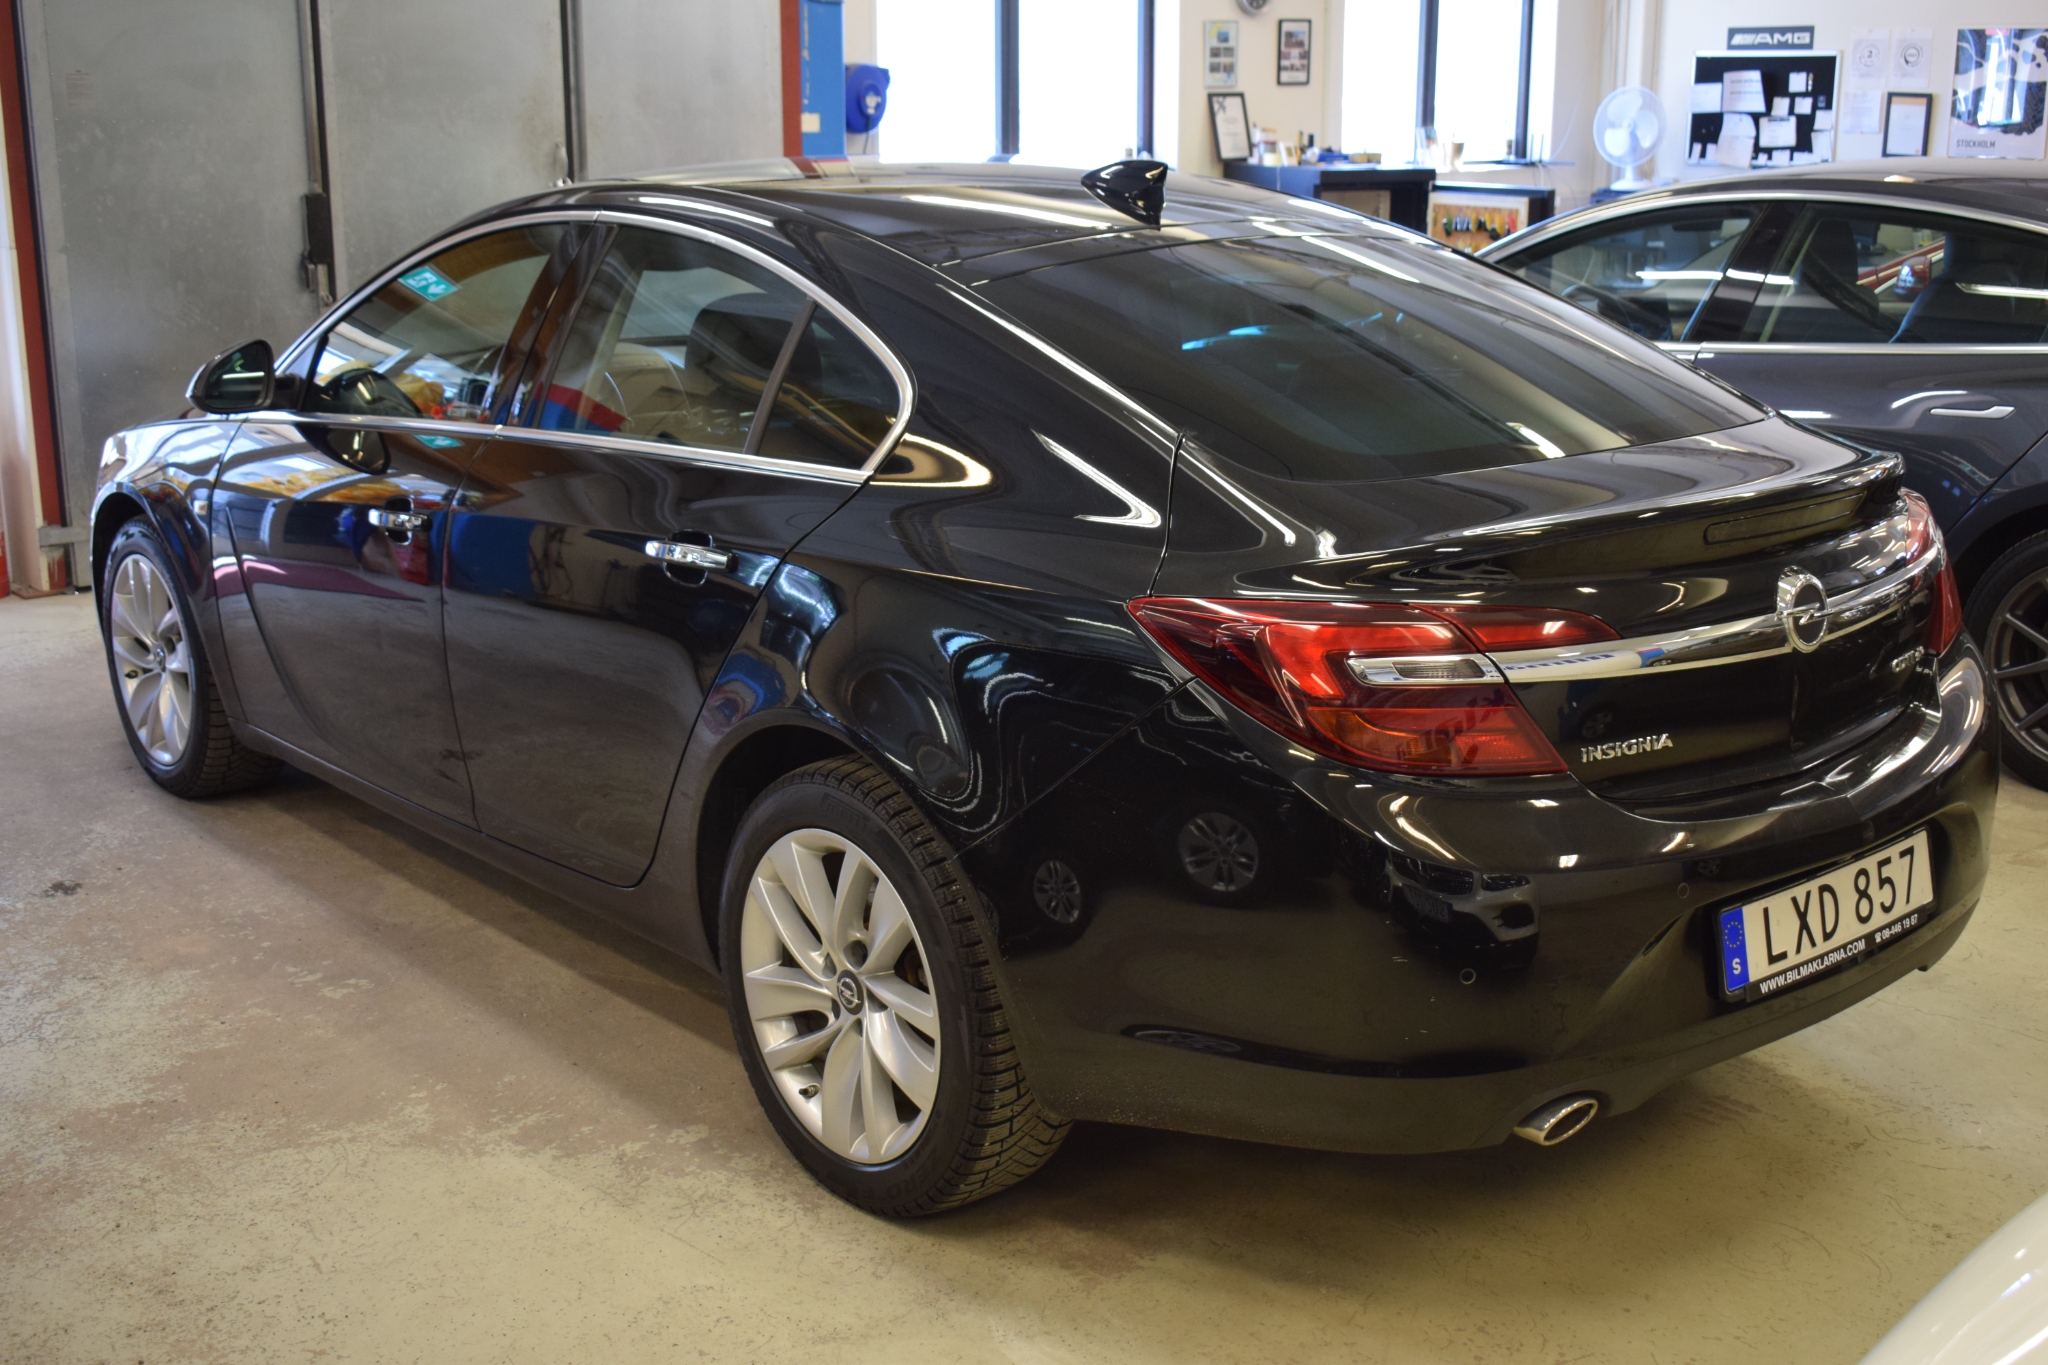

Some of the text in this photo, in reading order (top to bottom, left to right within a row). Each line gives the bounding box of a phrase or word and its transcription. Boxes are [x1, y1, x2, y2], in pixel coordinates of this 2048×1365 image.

[1754, 31, 1811, 45] AMG
[1956, 139, 1996, 149] STOCKHOLM
[1581, 733, 1673, 763] INSIGNIA
[1763, 845, 1915, 966] LXD 857
[1760, 938, 1866, 994] WWW.BILMAKLARNA.COM
[1902, 917, 1910, 929] 19
[1910, 913, 1918, 926] 87
[1732, 957, 1741, 975] S
